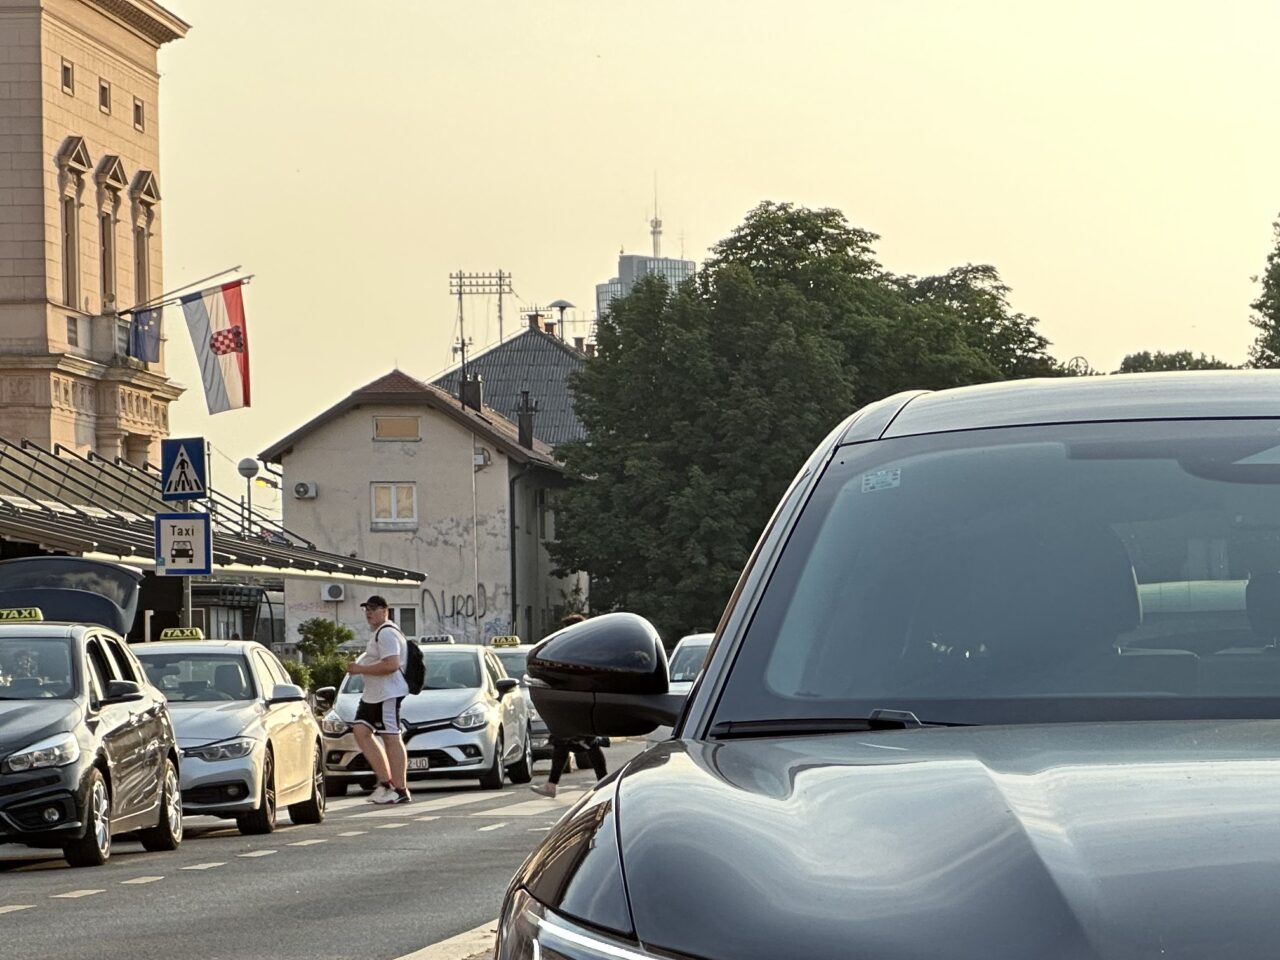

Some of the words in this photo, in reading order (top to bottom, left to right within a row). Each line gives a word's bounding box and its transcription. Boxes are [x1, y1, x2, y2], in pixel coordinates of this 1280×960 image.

[170, 525, 195, 536] Taxi
[1, 609, 36, 619] TAXI
[165, 629, 197, 637] TAXI
[495, 636, 516, 644] TAXI
